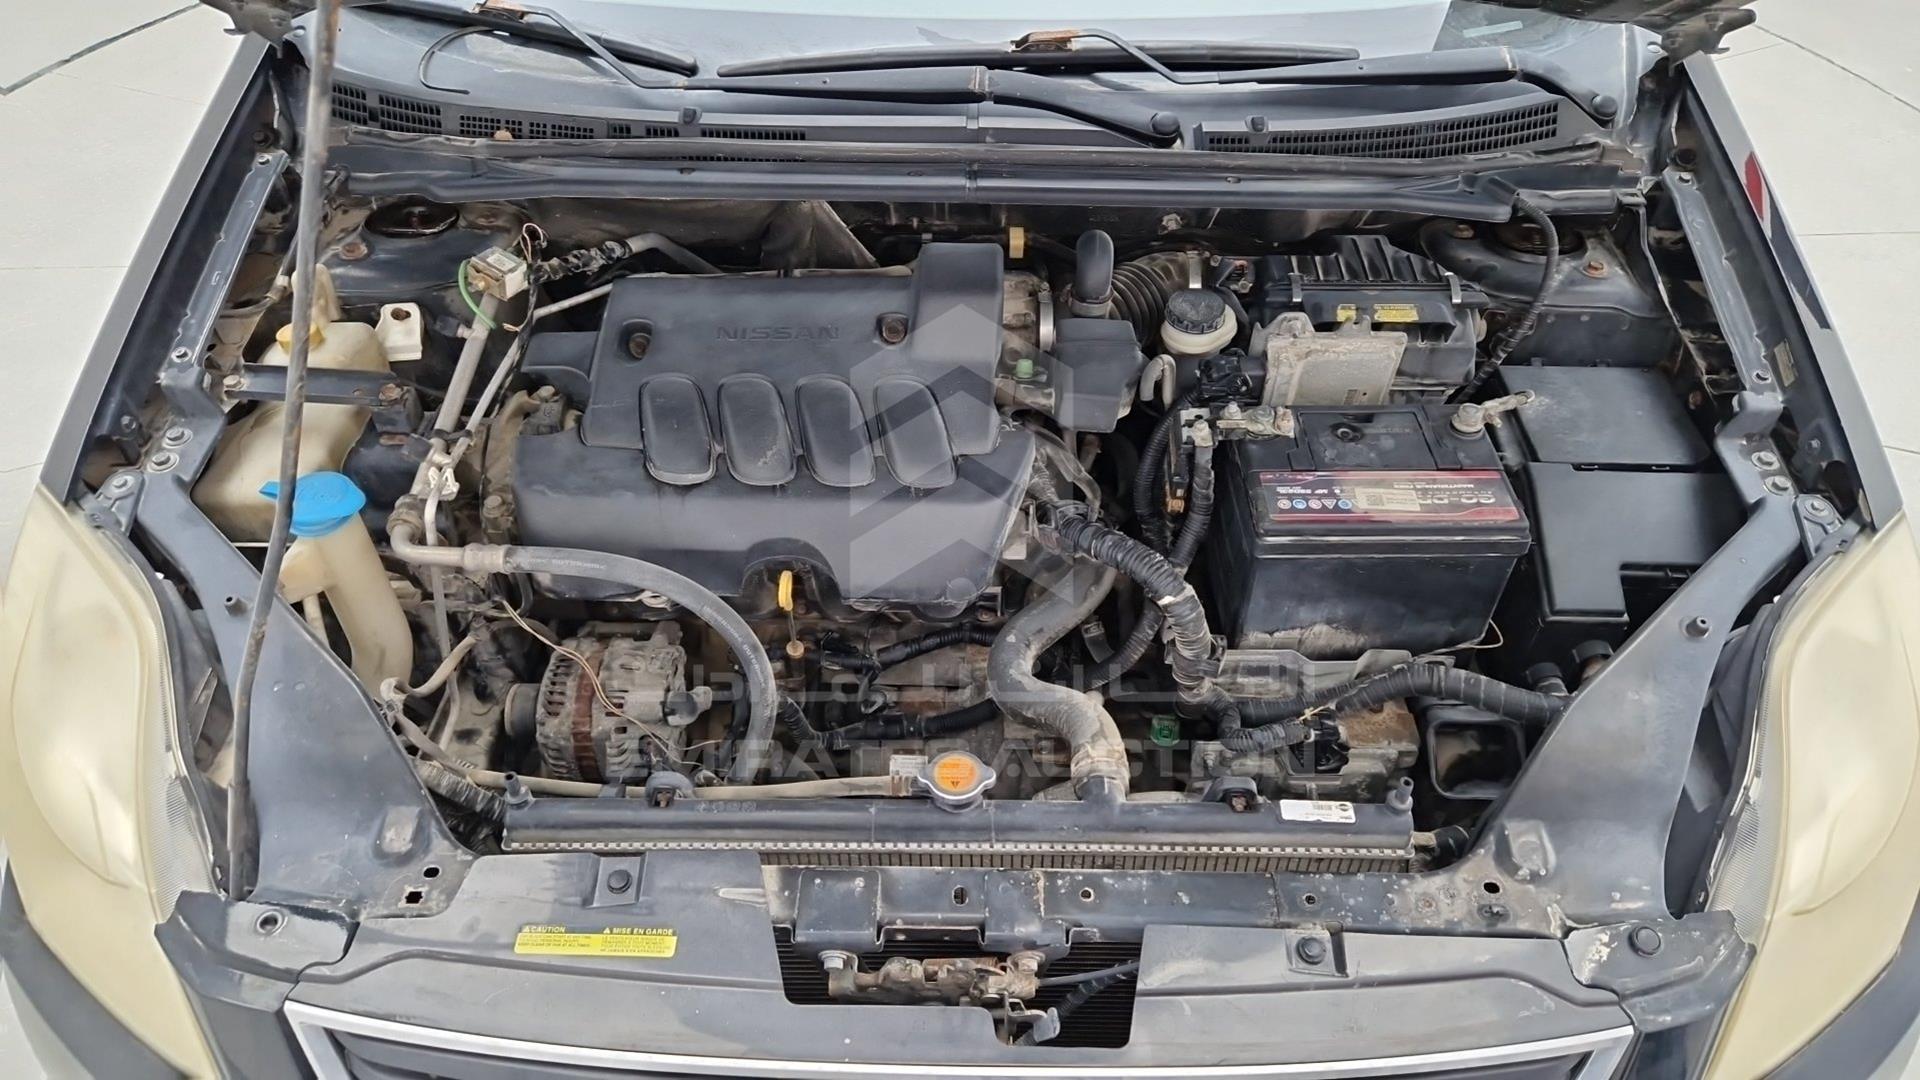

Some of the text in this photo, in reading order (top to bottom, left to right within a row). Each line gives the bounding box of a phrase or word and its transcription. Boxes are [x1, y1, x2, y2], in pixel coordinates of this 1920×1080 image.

[716, 325, 840, 341] NISSAN
[612, 927, 674, 936] MISE EN GARDE
